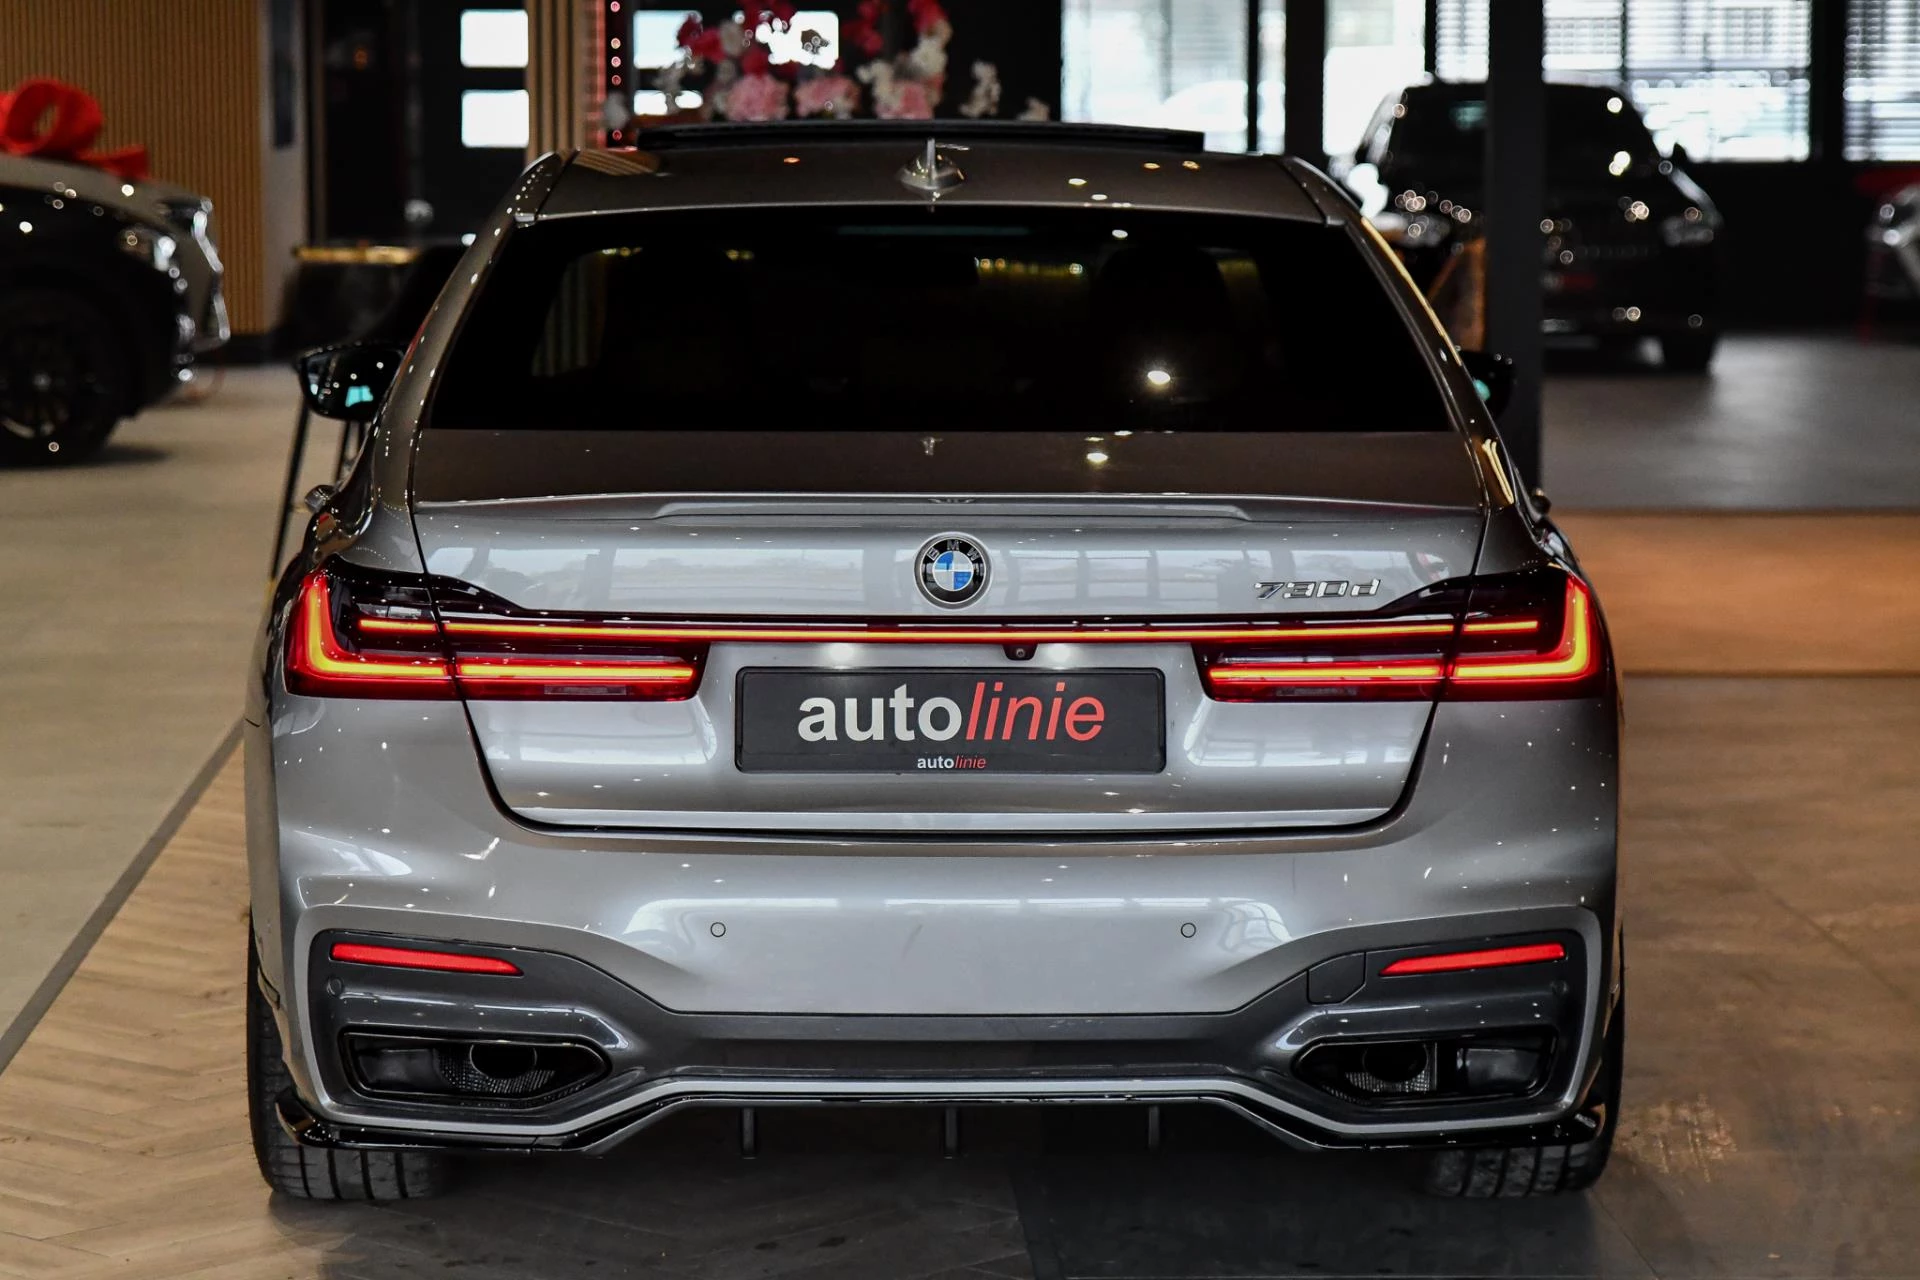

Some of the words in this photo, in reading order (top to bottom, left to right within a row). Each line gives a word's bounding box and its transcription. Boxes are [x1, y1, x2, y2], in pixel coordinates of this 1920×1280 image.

[927, 539, 980, 561] BMW
[1255, 578, 1381, 600] 730d
[798, 682, 1105, 742] autolinie
[917, 755, 987, 769] autolinie
